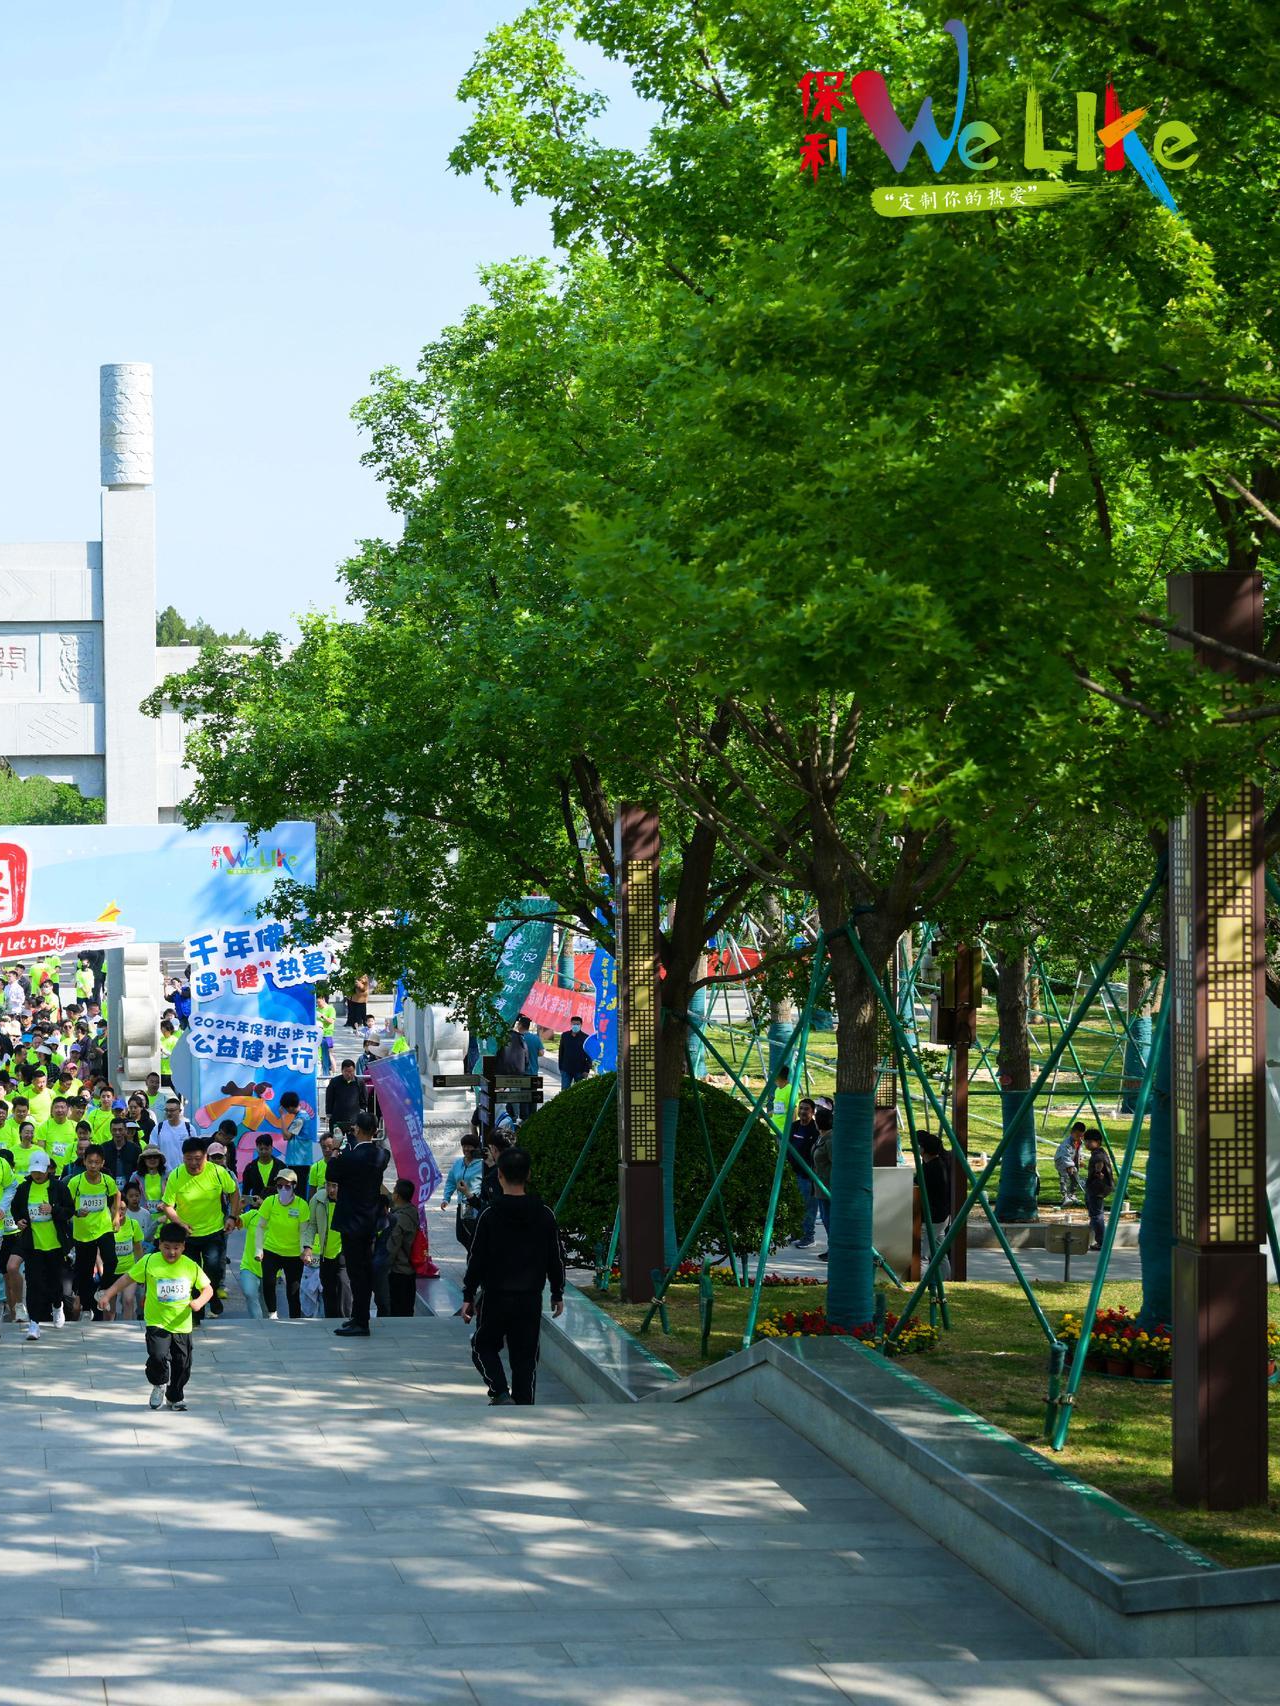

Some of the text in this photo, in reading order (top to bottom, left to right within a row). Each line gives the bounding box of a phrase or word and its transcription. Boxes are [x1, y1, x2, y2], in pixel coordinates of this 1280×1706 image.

[222, 834, 255, 868] We
[7, 937, 37, 951] Let's
[40, 931, 67, 952] Poly
[521, 952, 538, 964] 152
[194, 1016, 319, 1043] 2025年保利进步节
[191, 1033, 314, 1069] 公益健步行
[160, 1286, 184, 1295] A0453
